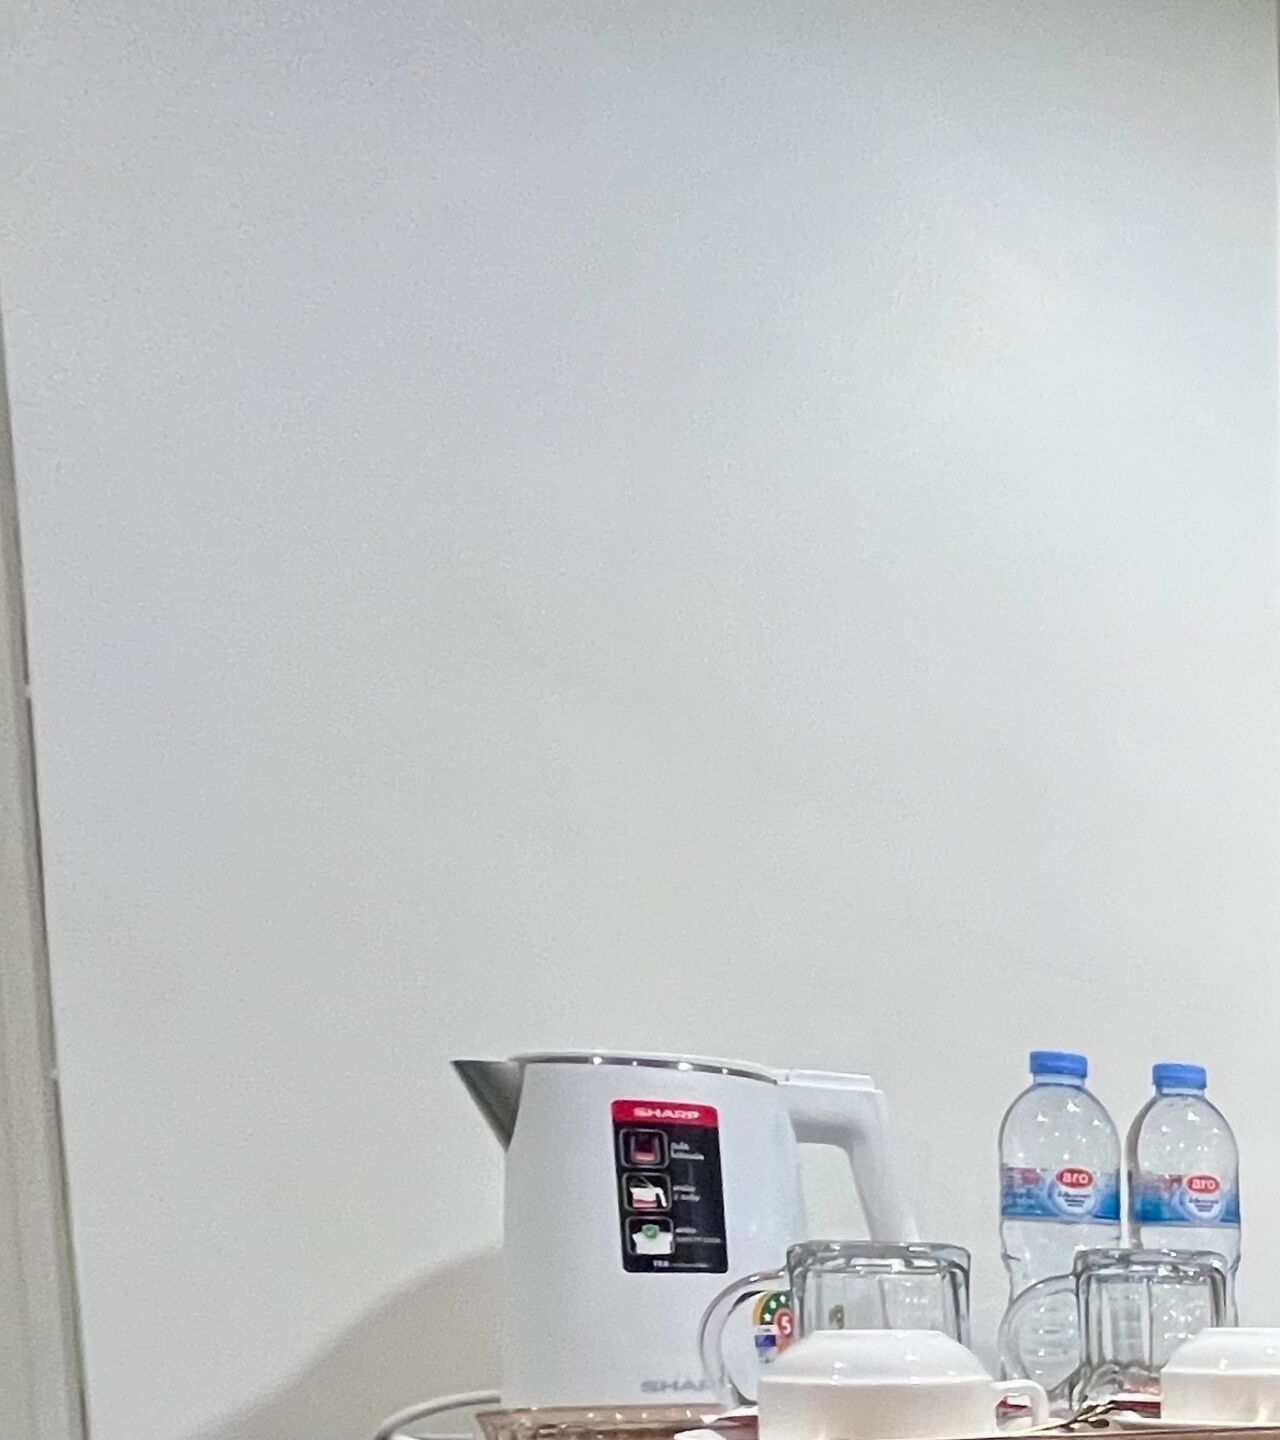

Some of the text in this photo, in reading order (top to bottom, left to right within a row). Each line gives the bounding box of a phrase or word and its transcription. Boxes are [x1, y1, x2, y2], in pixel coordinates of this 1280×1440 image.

[633, 1106, 700, 1120] SHARP
[1062, 1171, 1089, 1184] aro
[1191, 1178, 1216, 1191] aro
[780, 1314, 792, 1335] 5
